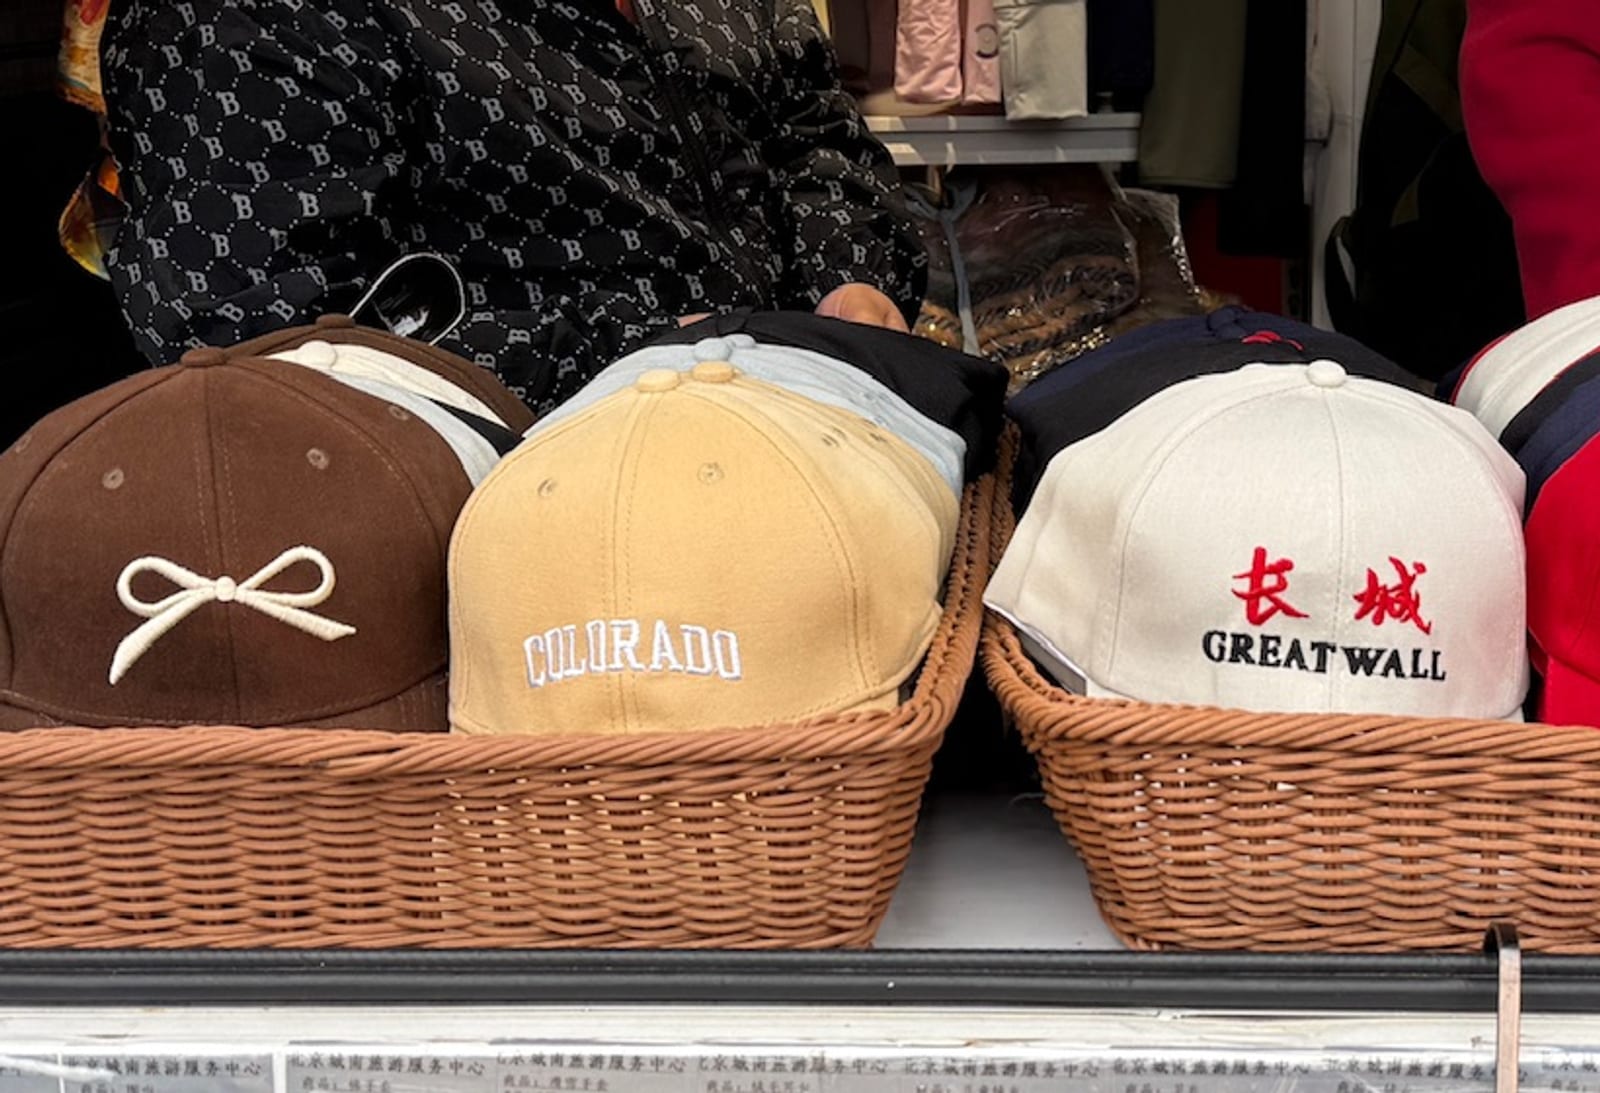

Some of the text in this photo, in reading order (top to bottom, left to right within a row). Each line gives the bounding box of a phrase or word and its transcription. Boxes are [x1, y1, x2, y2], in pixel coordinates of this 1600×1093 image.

[177, 2, 196, 27] B
[325, 10, 348, 31] B
[440, 2, 467, 23] B
[477, 0, 502, 23] B
[199, 24, 216, 47] B
[161, 45, 182, 69] B
[229, 49, 252, 73] B
[332, 43, 358, 66] B
[485, 60, 512, 81] B
[274, 76, 301, 98] B
[436, 71, 461, 95] B
[562, 84, 587, 105] B
[145, 88, 167, 112] B
[215, 91, 240, 116] B
[480, 97, 505, 123] B
[527, 86, 548, 112] B
[322, 100, 348, 126] B
[604, 106, 627, 129] B
[183, 114, 199, 137] B
[261, 119, 287, 143] B
[525, 124, 546, 147] B
[564, 116, 583, 140] B
[134, 132, 152, 155] B
[201, 136, 224, 160] B
[306, 143, 331, 167] B
[425, 142, 445, 164] B
[464, 138, 488, 162] B
[594, 145, 610, 167] B
[167, 157, 187, 180] B
[245, 161, 270, 183] B
[506, 164, 529, 185] B
[231, 192, 254, 220] B
[297, 190, 320, 217] B
[485, 193, 508, 214] B
[547, 185, 567, 206] B
[172, 200, 192, 224] B
[583, 207, 604, 227] B
[830, 209, 851, 226] B
[269, 227, 288, 251] B
[465, 220, 486, 241] B
[620, 228, 641, 250] B
[729, 226, 747, 247] B
[147, 237, 169, 260] B
[209, 232, 230, 257] B
[561, 238, 584, 262] B
[852, 243, 867, 265] B
[502, 246, 524, 269] B
[127, 263, 142, 285] B
[185, 270, 208, 293] B
[467, 281, 488, 305] B
[524, 280, 544, 304] B
[170, 298, 193, 320] B
[215, 302, 245, 323] B
[267, 299, 296, 323] B
[507, 328, 531, 345] B
[474, 352, 496, 370] B
[523, 619, 742, 688] COLORADO
[1202, 630, 1447, 681] GREAT WALL
